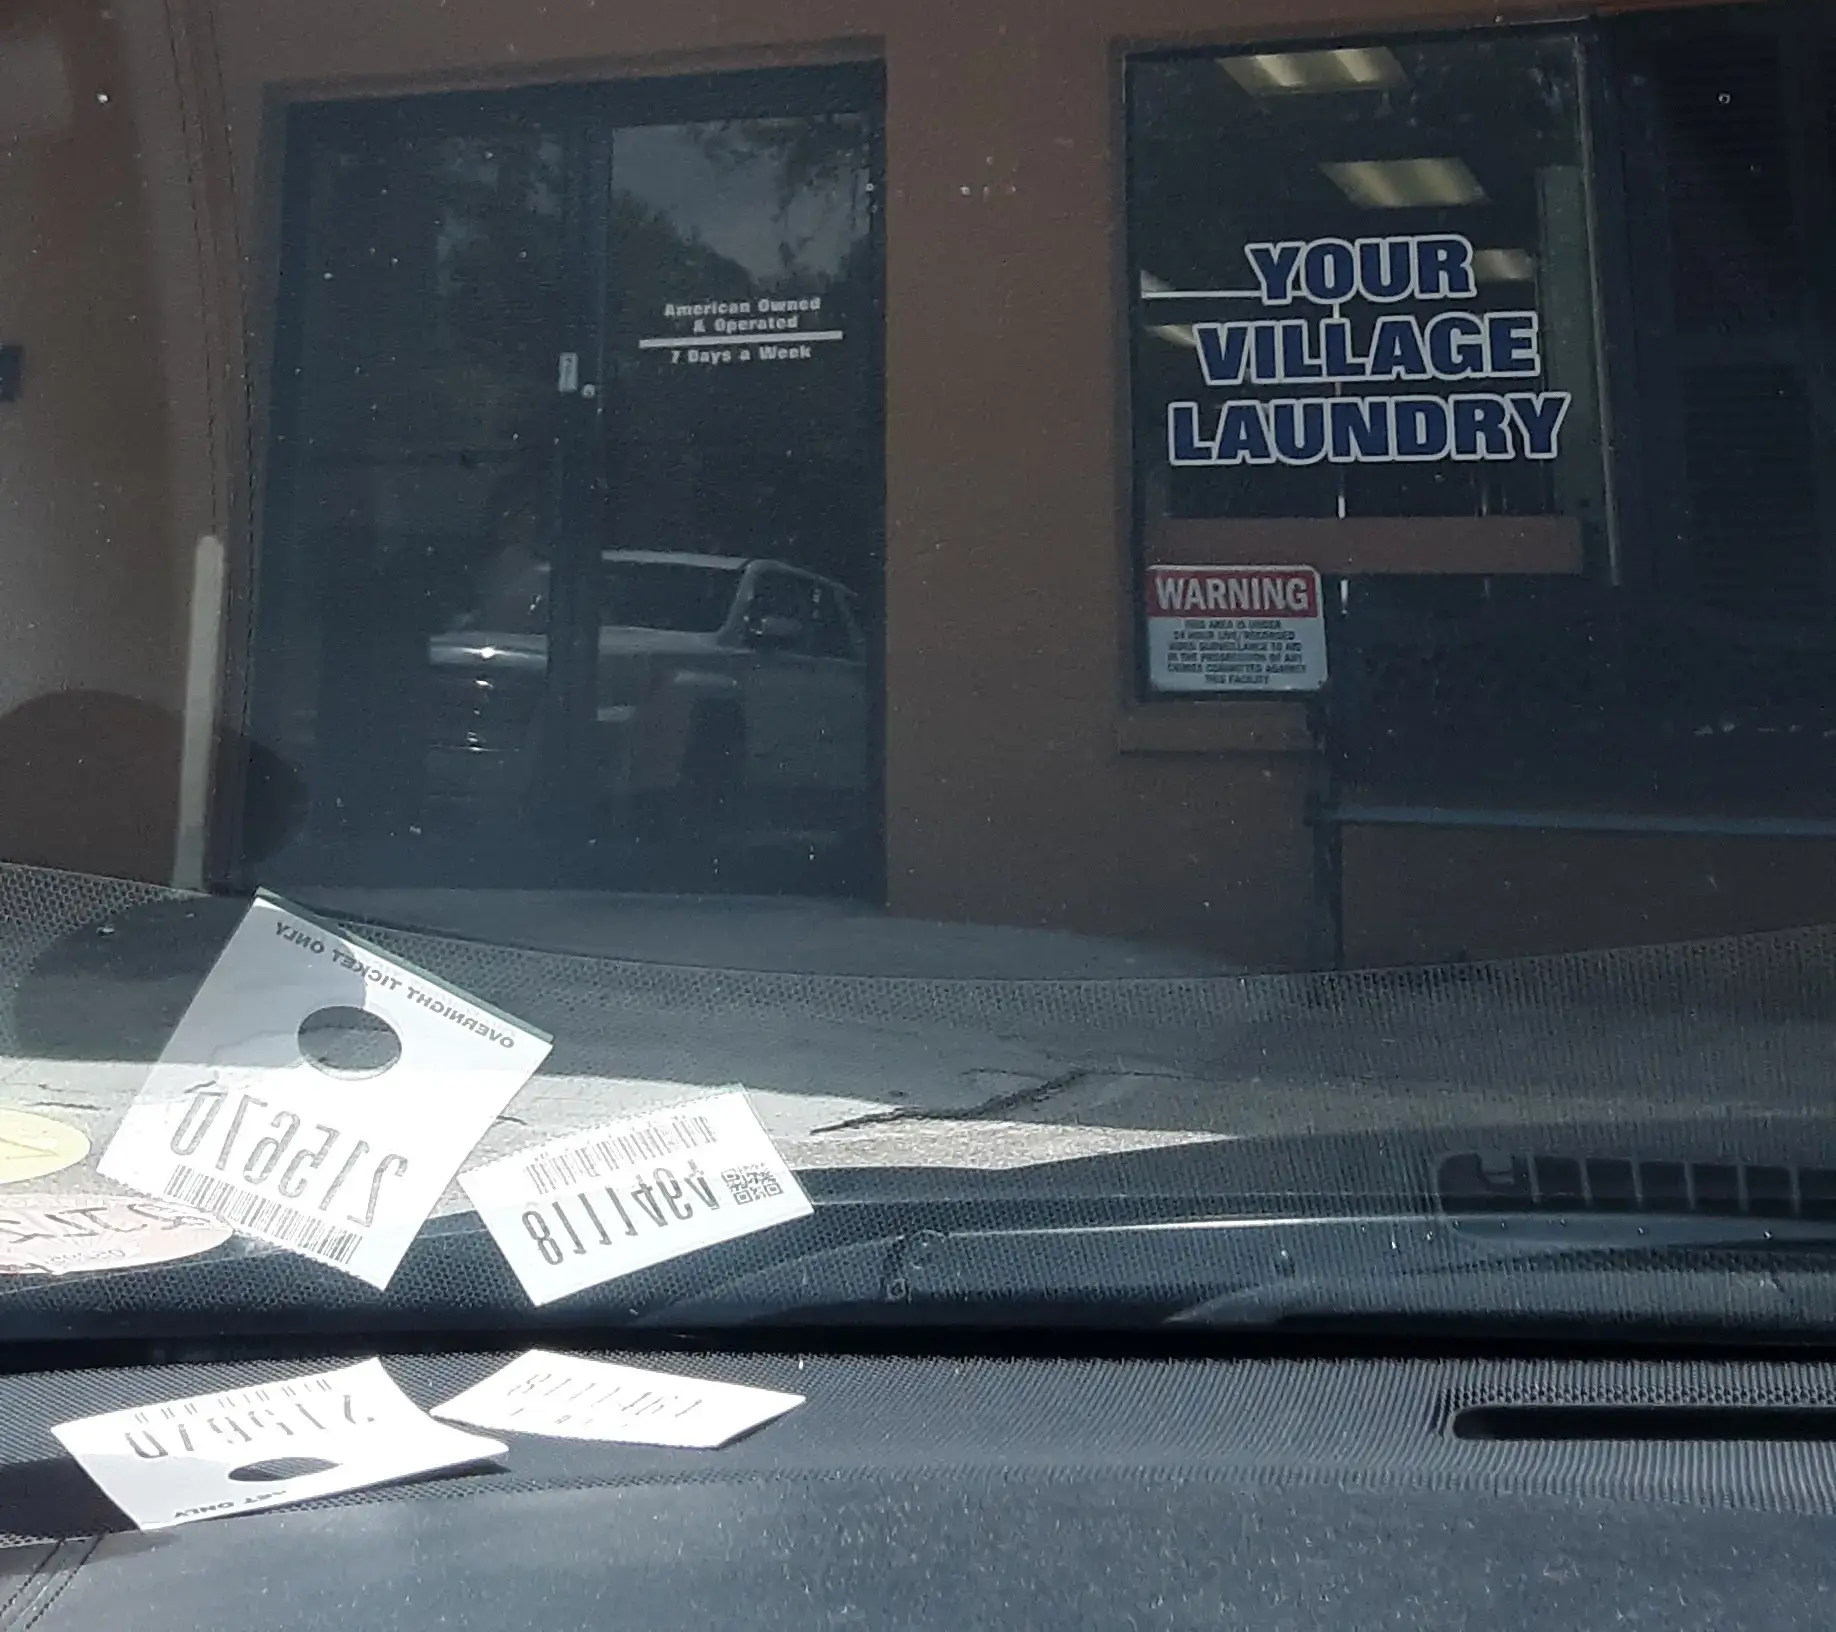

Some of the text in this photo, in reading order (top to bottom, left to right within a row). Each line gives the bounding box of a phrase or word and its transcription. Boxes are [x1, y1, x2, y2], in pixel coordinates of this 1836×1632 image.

[1245, 234, 1477, 305] YOUR
[663, 297, 821, 317] American Owned
[714, 316, 798, 333] Operated
[671, 345, 812, 365] 7 Days a Week
[1194, 311, 1541, 386] VILLAGE
[1166, 392, 1571, 466] LAUNDRY
[1155, 577, 1308, 612] WARNING
